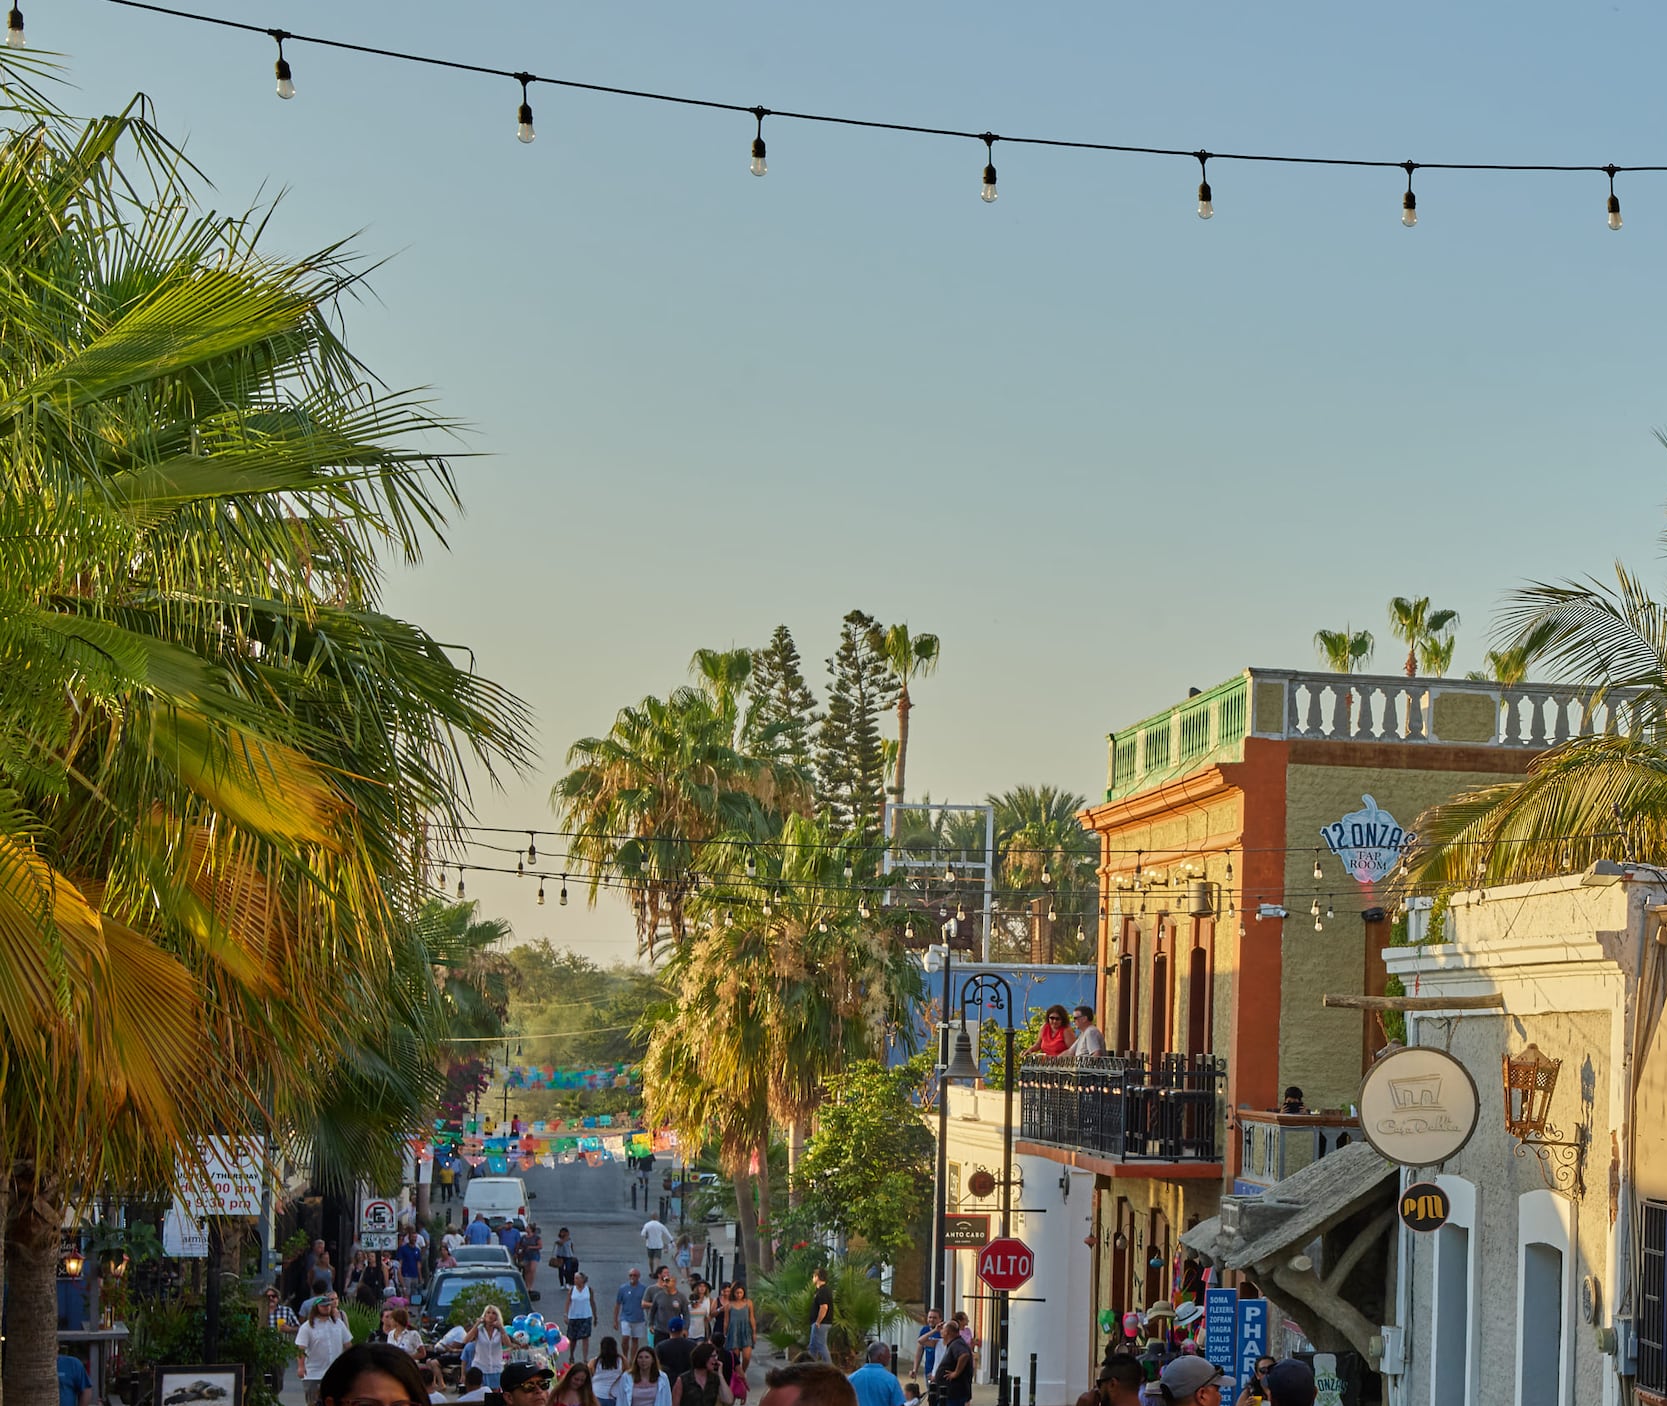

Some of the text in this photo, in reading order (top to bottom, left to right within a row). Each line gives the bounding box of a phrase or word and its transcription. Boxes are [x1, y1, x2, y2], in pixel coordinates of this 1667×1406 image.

[1322, 823, 1349, 853] 12
[1359, 850, 1382, 861] TAP
[1350, 859, 1387, 870] ROOM
[229, 1200, 251, 1211] pm
[982, 1253, 1030, 1276] ALTO
[1209, 1296, 1229, 1304] SOMA
[1209, 1306, 1234, 1314] FLEXERIL
[1209, 1316, 1232, 1324] ZOFRAN
